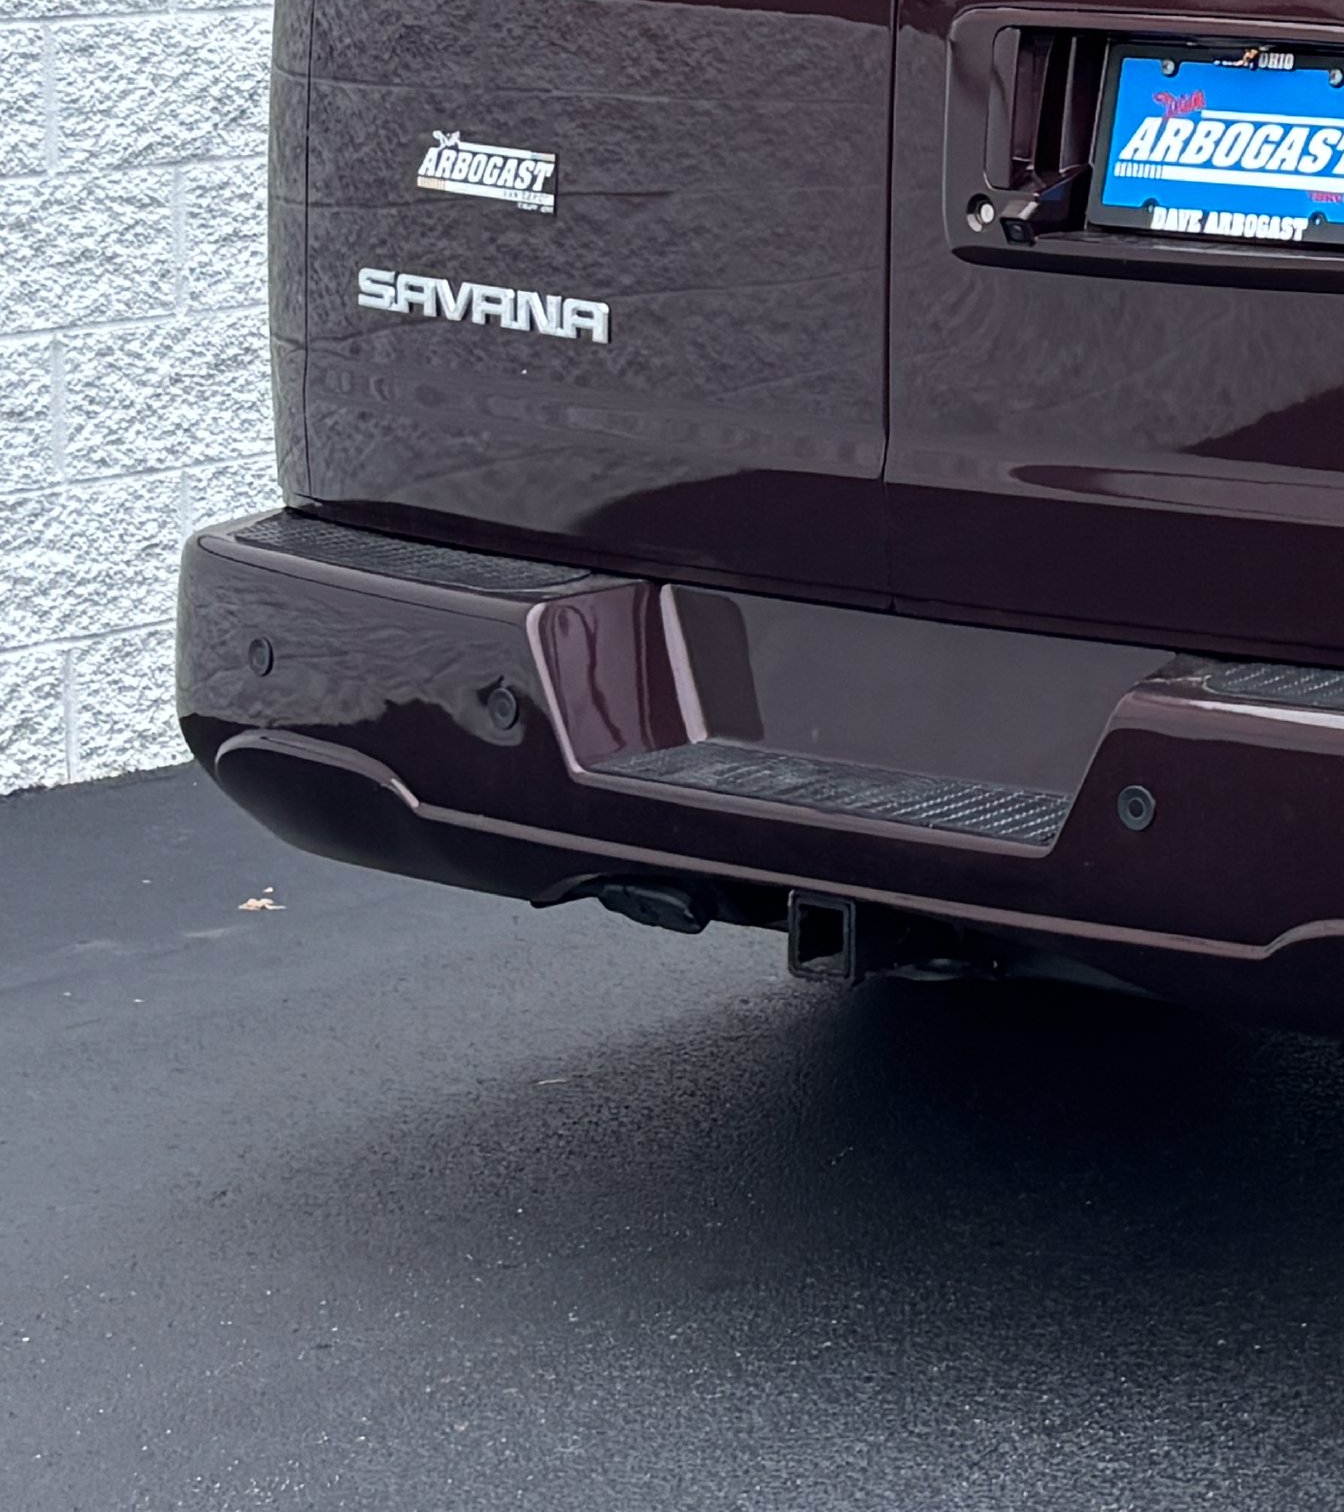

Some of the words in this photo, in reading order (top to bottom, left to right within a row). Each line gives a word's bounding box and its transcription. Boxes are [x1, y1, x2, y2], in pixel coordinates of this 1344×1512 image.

[1258, 52, 1294, 70] OHIO
[418, 147, 555, 191] ARBOGAST
[1151, 206, 1203, 233] DAVE
[1203, 211, 1308, 241] ARBOGAST
[358, 267, 610, 344] SAVANA
